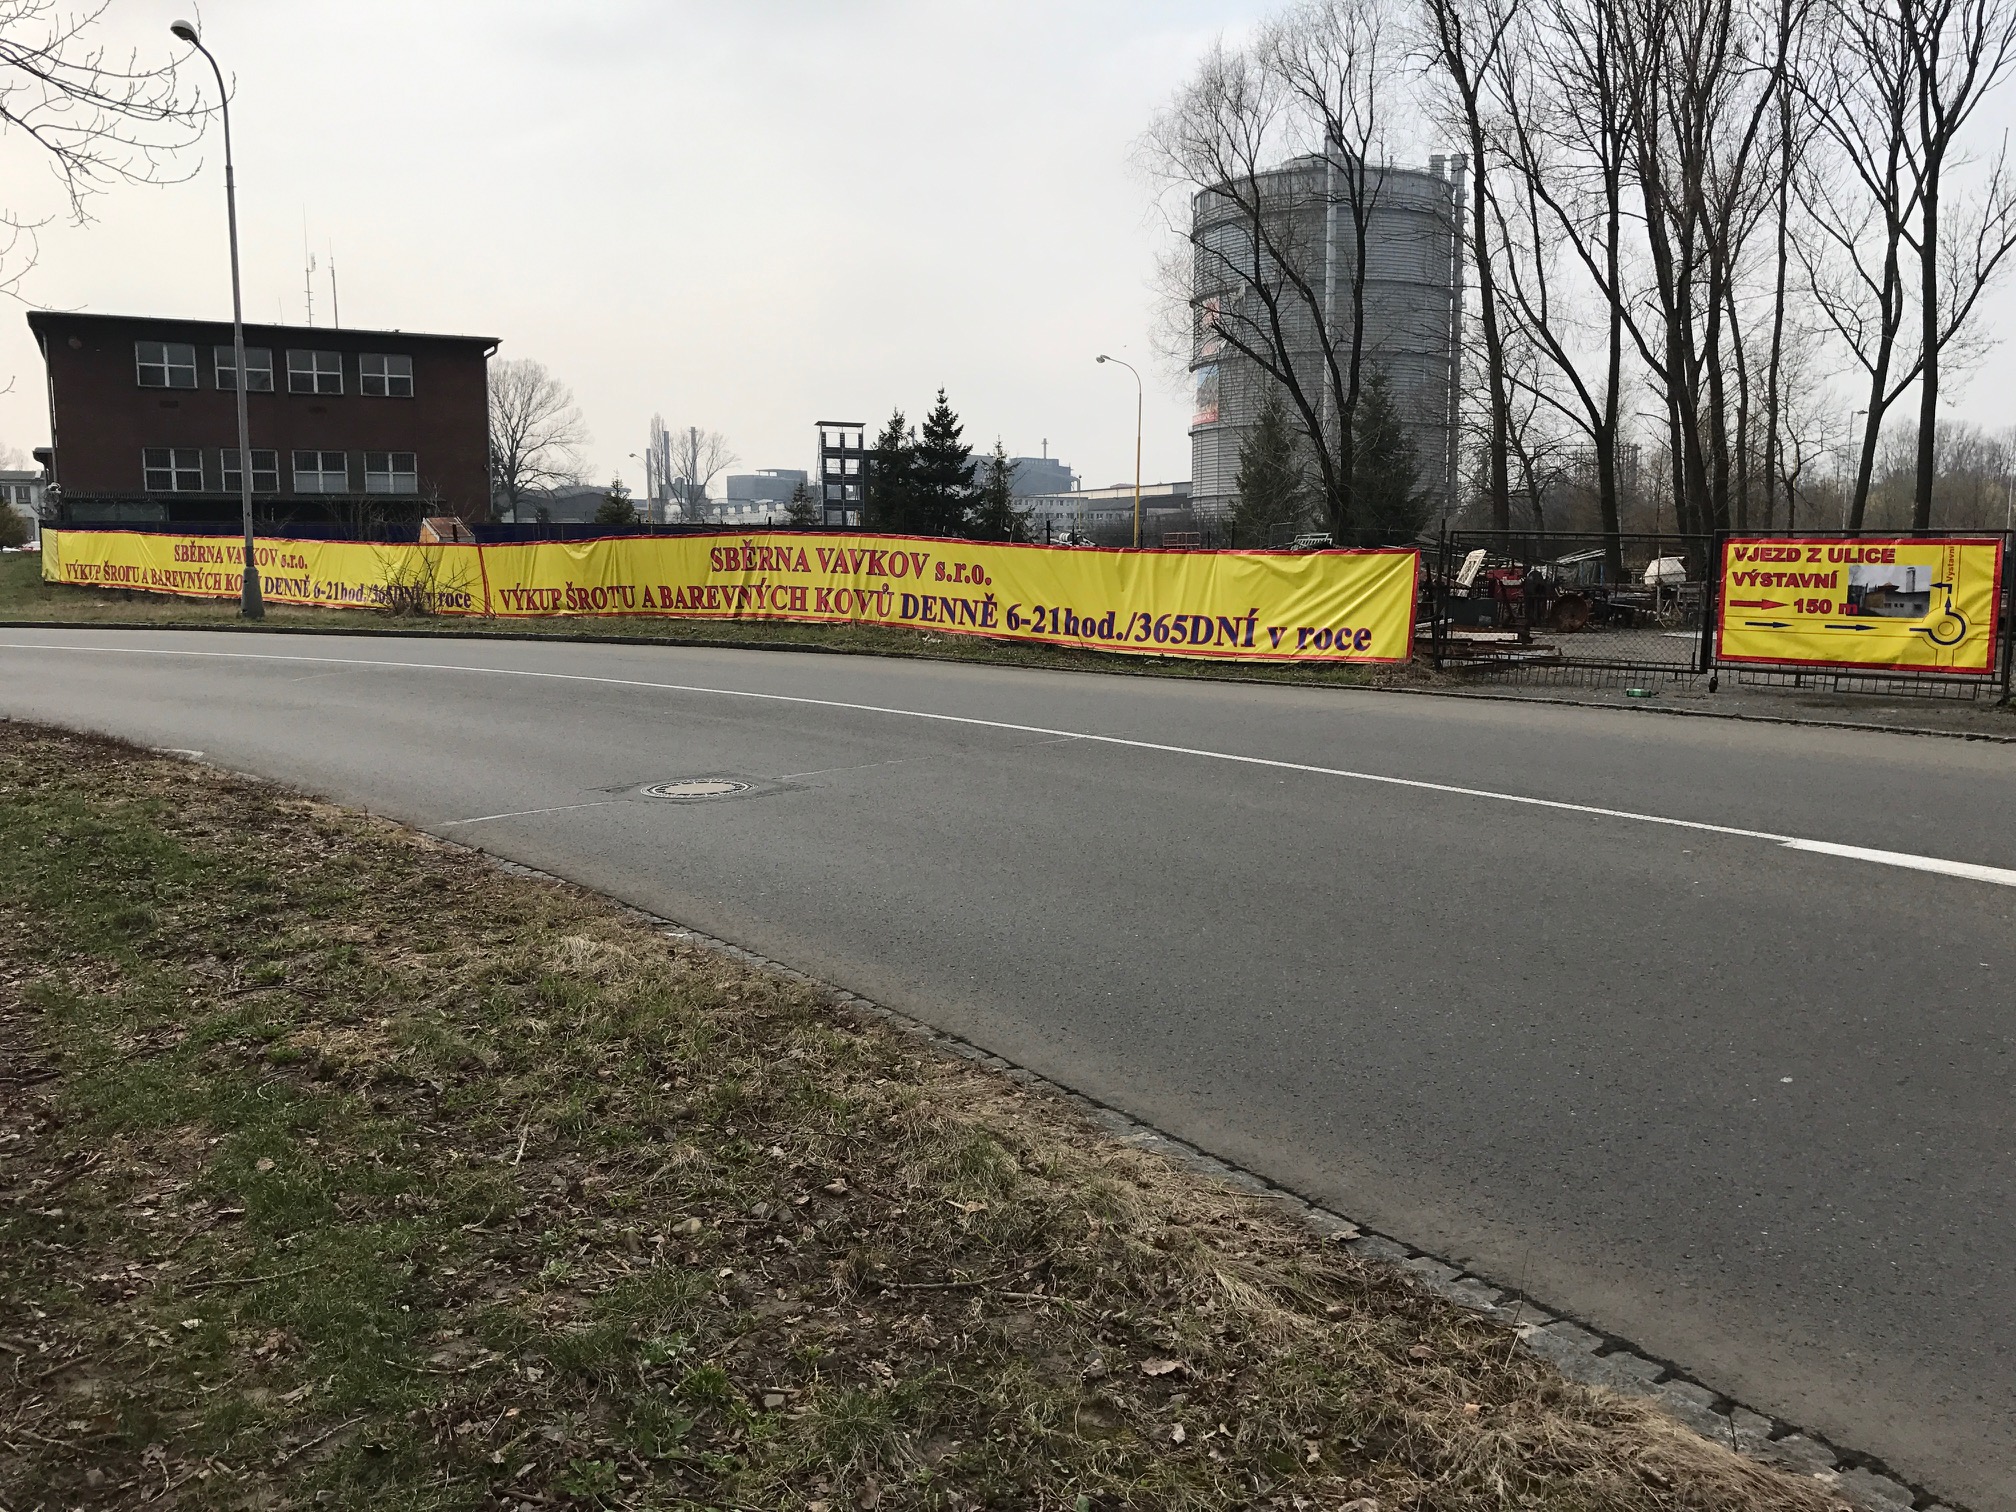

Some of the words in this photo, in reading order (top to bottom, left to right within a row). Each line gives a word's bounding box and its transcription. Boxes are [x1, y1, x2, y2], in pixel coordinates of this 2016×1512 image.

[174, 540, 223, 563] SBĚRNA
[281, 553, 308, 569] s.r.o.
[711, 539, 811, 573] SBĚRNA
[816, 547, 930, 579] VAVKOV
[935, 561, 992, 586] s.r.o.
[1734, 547, 1802, 563] VJEZD
[1806, 547, 1822, 563] Z
[1828, 547, 1896, 564] ULICE
[65, 559, 101, 580] VÝKUP
[103, 560, 139, 583] ŠROTU
[142, 567, 149, 584] A
[150, 567, 222, 591] BAREVNÝCH
[225, 573, 262, 592] KO
[264, 574, 311, 598] DENNĚ
[438, 591, 472, 608] roce
[1732, 569, 1837, 589] VÝSTAVNÍ
[500, 583, 562, 611] VÝKUP
[565, 581, 635, 610] ŠROTU
[641, 585, 657, 609] A
[657, 577, 808, 612] BAREVNÝCH
[815, 583, 894, 618] KOVŮ
[900, 592, 998, 629] DENNĚ
[1006, 602, 1260, 649] 6-21hod./365DNÍ
[1266, 626, 1288, 650] v
[1295, 627, 1372, 652] roce
[1794, 598, 1832, 615] 150
[1838, 603, 1858, 616] m
